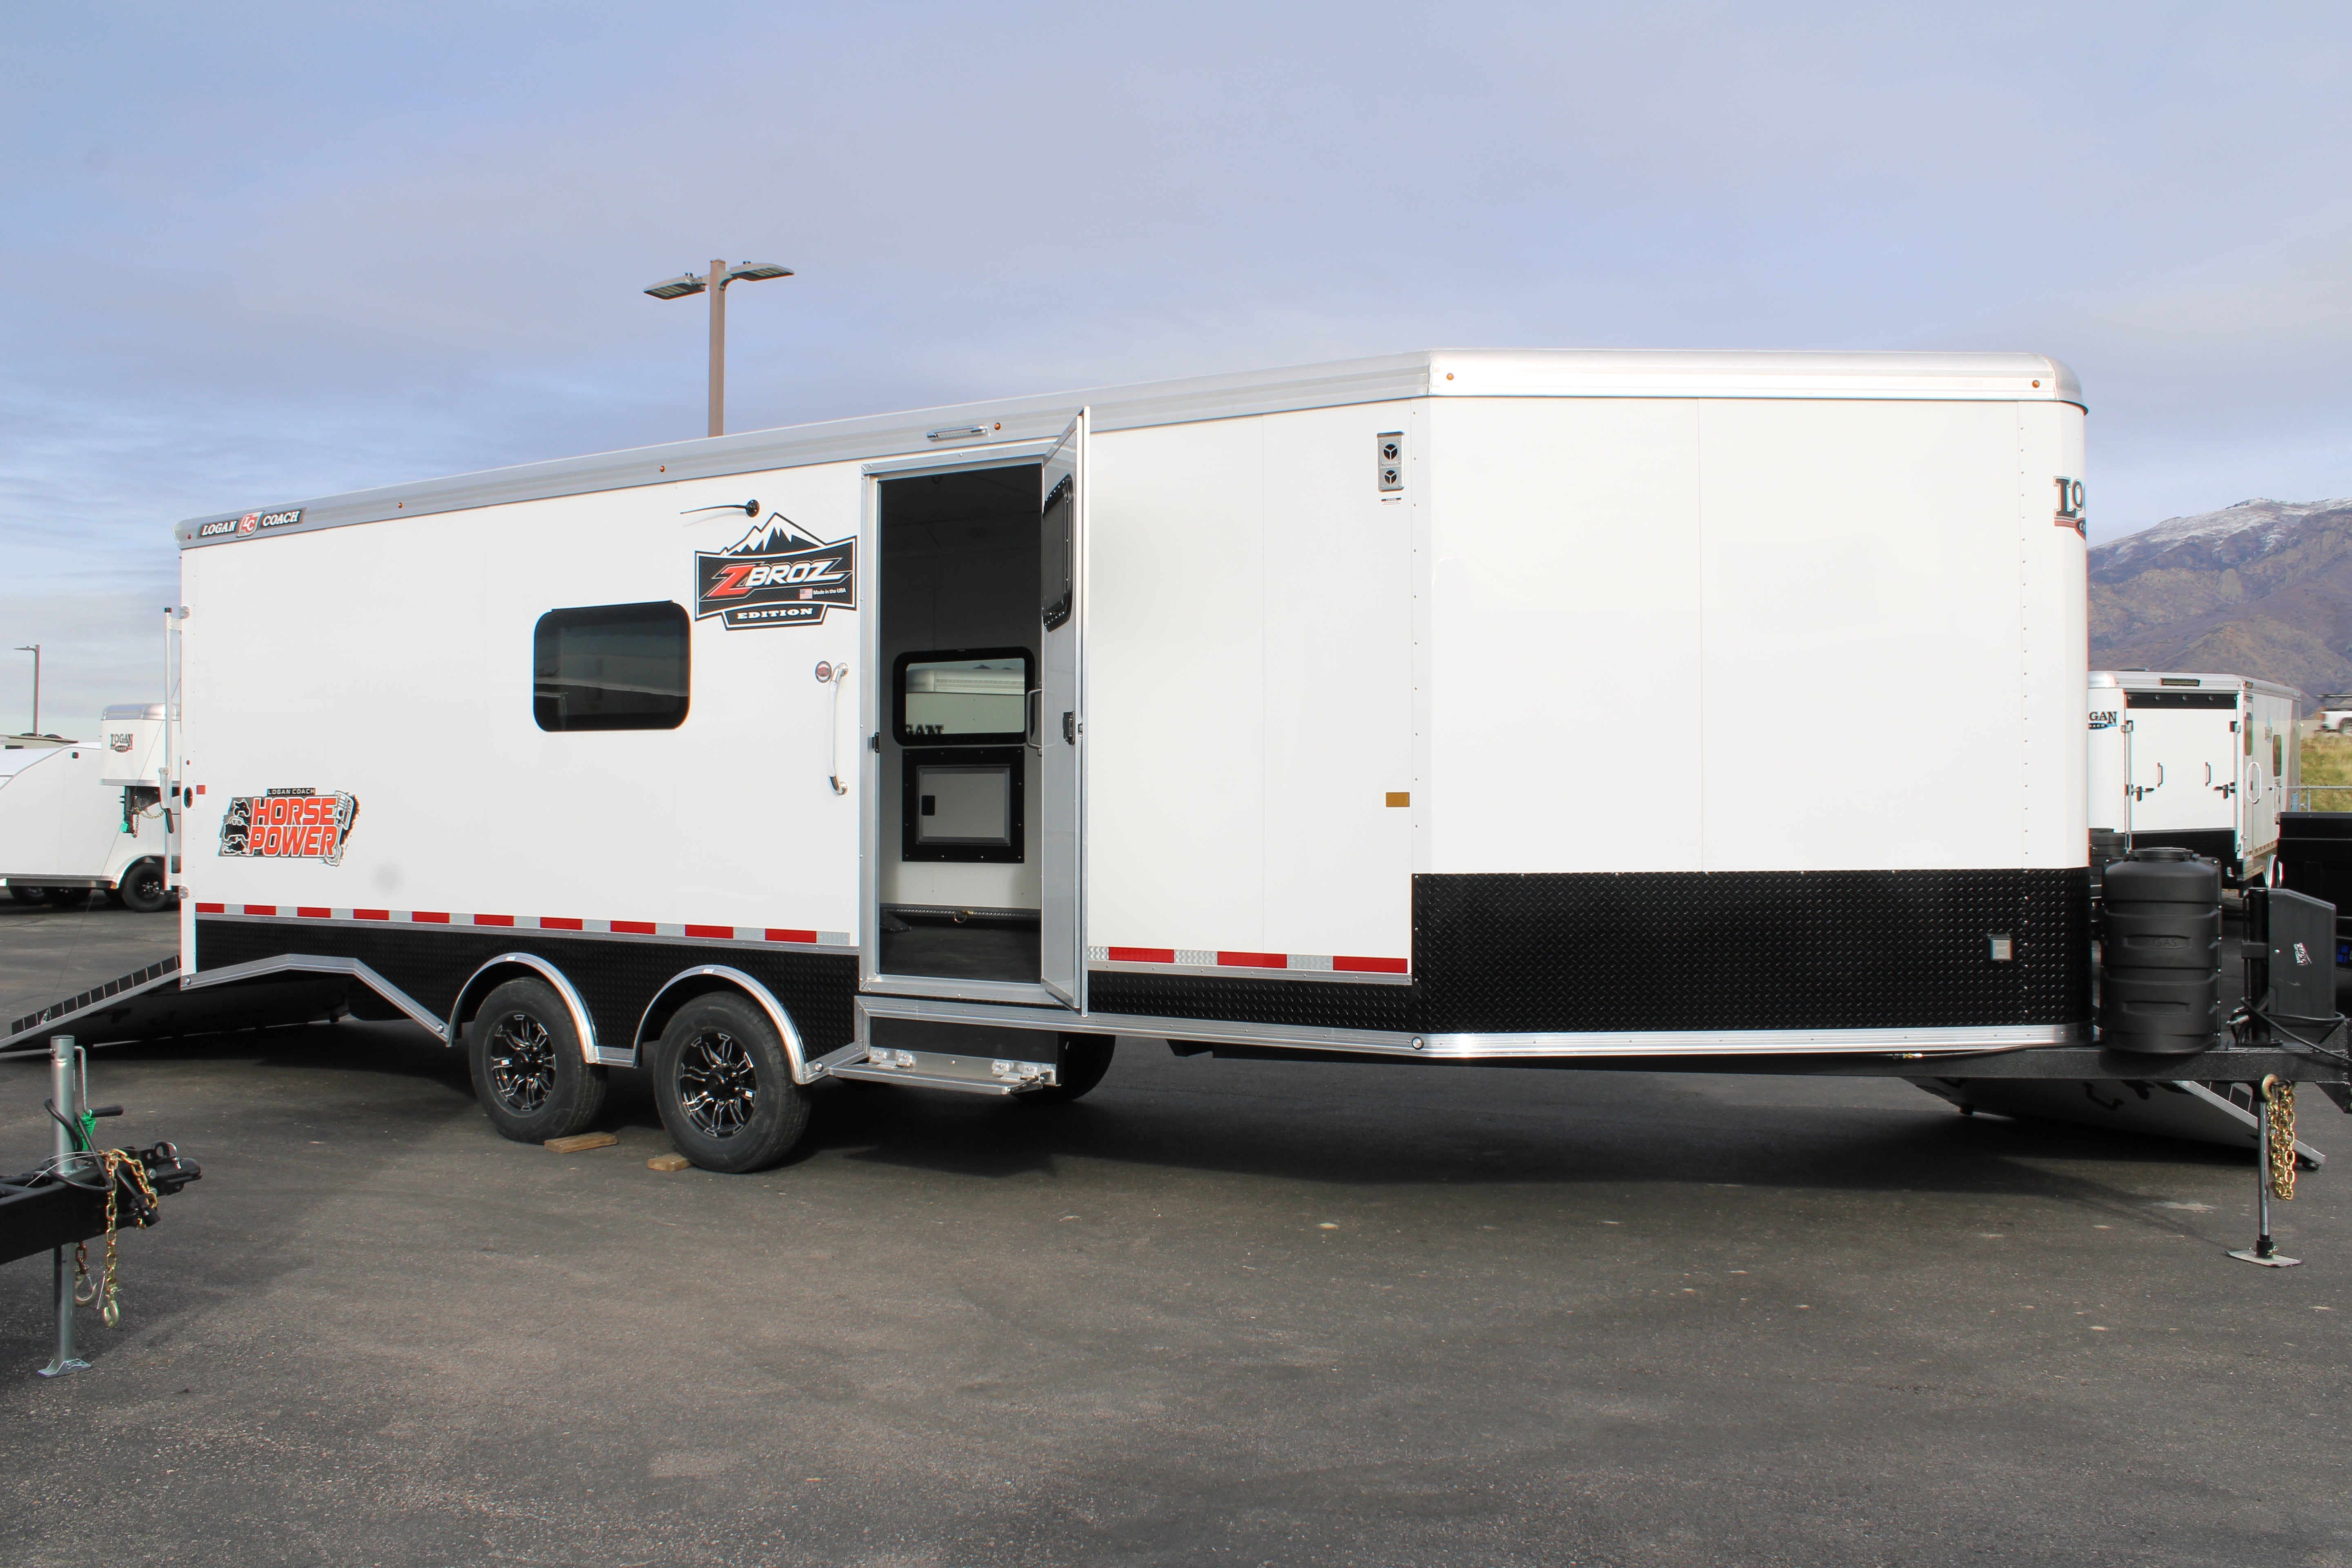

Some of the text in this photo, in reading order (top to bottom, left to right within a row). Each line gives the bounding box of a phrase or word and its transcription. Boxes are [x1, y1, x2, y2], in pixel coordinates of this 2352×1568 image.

[2054, 476, 2085, 520] LO
[201, 521, 237, 536] LOGAN
[262, 510, 301, 527] COACH
[706, 560, 846, 597] ZBROZ
[737, 608, 813, 620] EDITION
[110, 733, 134, 748] LOGAN
[252, 797, 337, 826] HORSE
[249, 826, 338, 856] POWER
[2153, 938, 2177, 947] GAS
